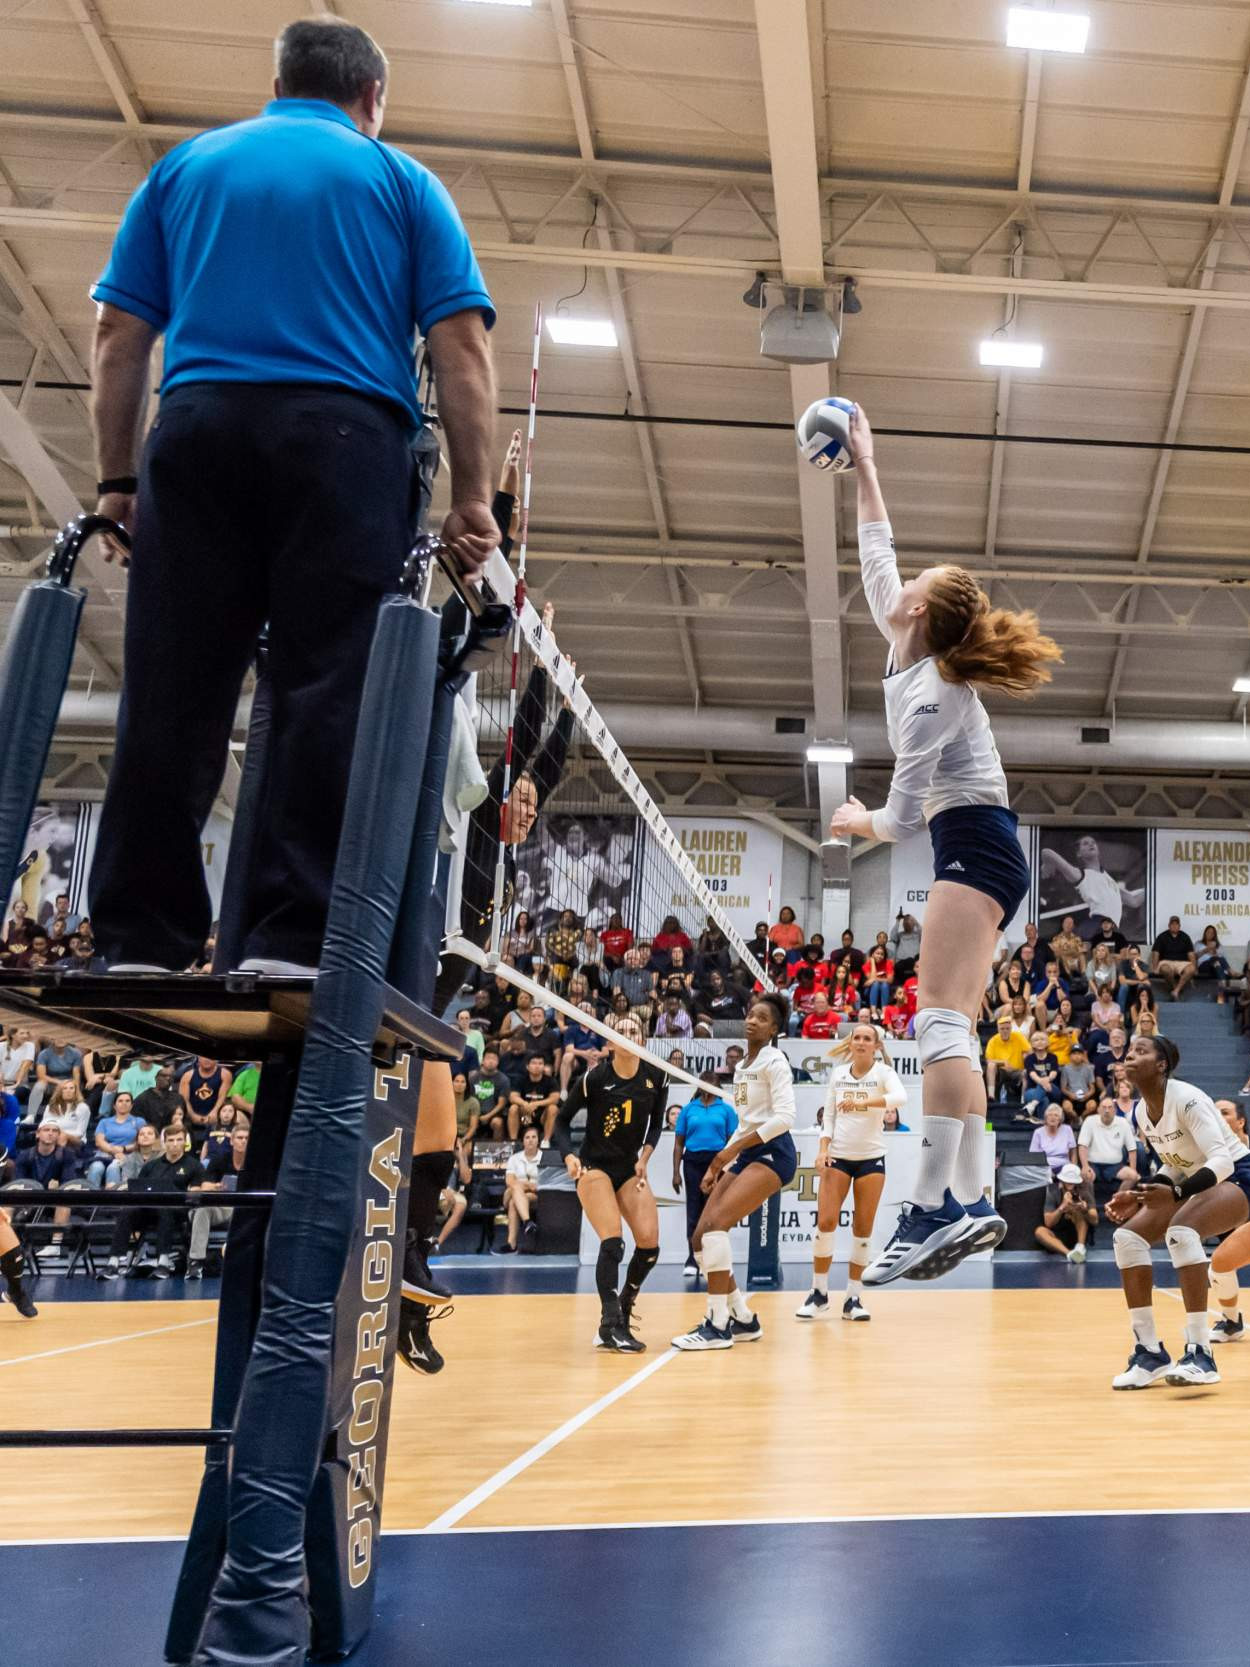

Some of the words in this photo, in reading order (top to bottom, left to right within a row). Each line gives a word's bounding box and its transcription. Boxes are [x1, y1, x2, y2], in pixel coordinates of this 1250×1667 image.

[913, 703, 940, 715] ACC
[681, 829, 747, 852] LAUREN
[686, 852, 741, 876] AUER
[1191, 863, 1249, 885] PREISS
[1205, 888, 1235, 901] 2003
[621, 1099, 633, 1125] 1
[346, 1126, 404, 1590] GEORGIA
